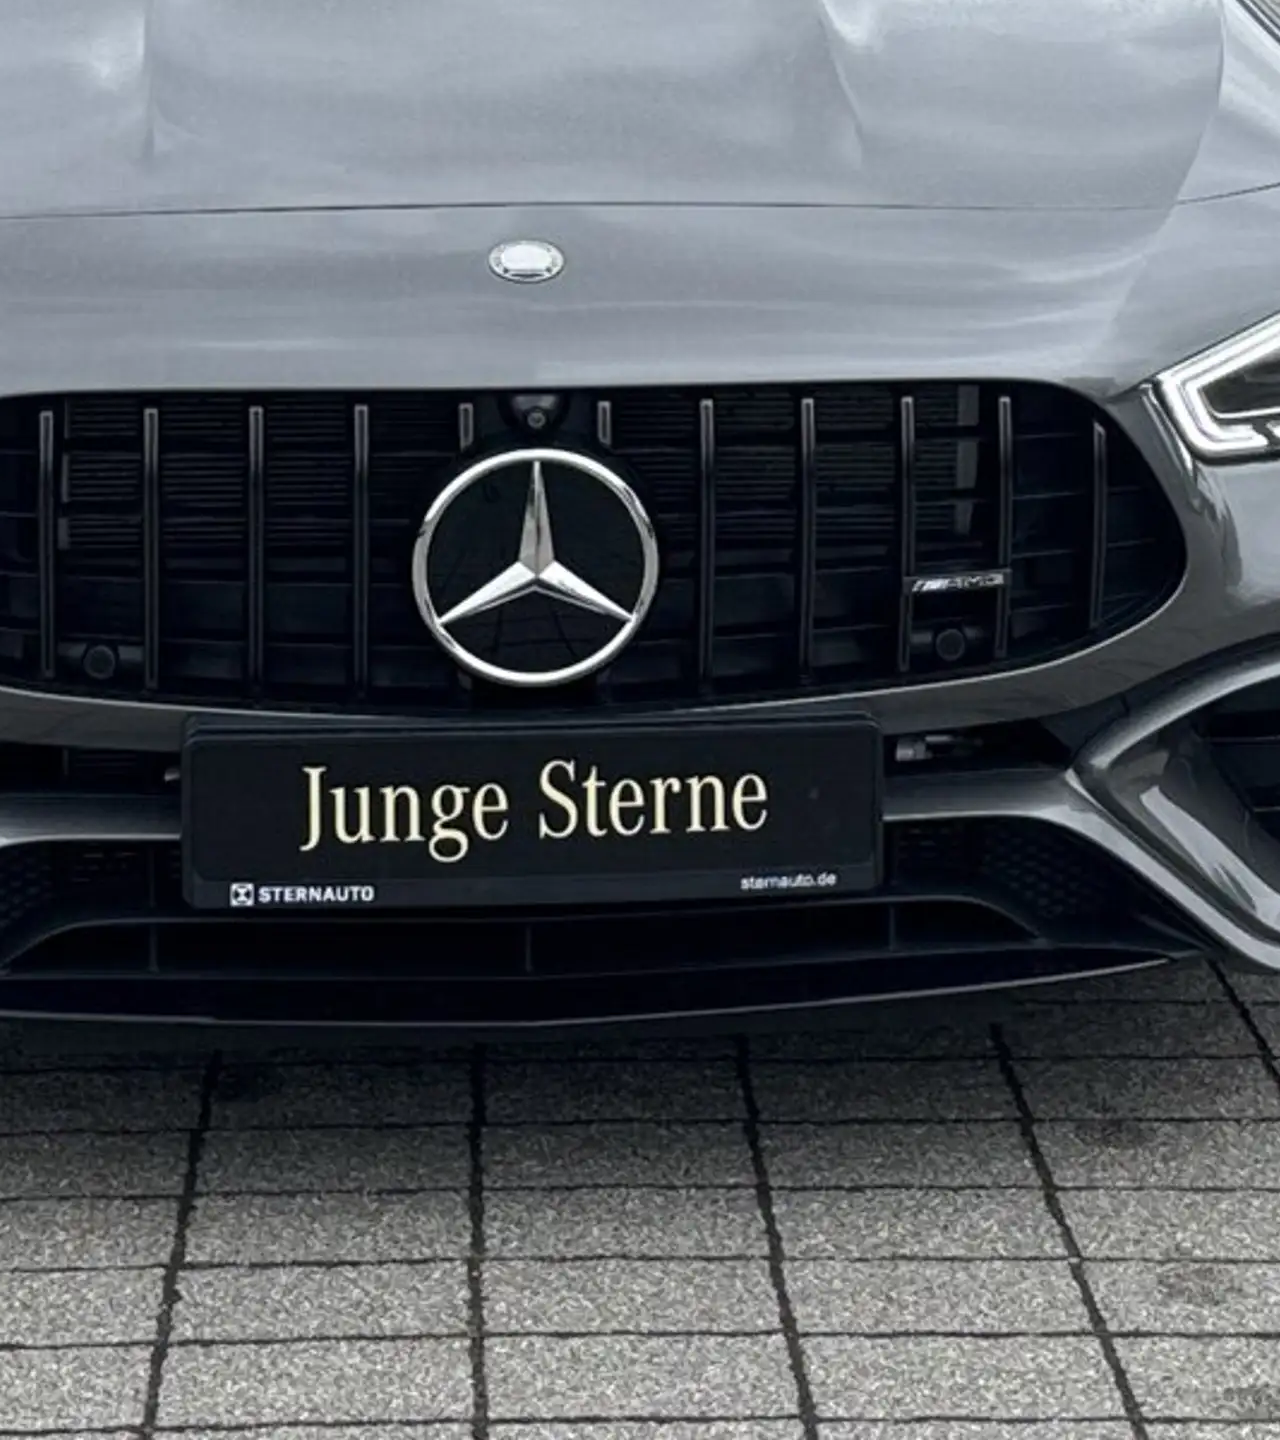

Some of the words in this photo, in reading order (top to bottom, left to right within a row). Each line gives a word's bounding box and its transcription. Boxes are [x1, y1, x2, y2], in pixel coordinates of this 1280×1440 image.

[300, 766, 510, 863] Junge
[539, 759, 768, 840] Sterne
[740, 871, 837, 890] sternauto.de
[258, 885, 375, 904] STERNAUTO
